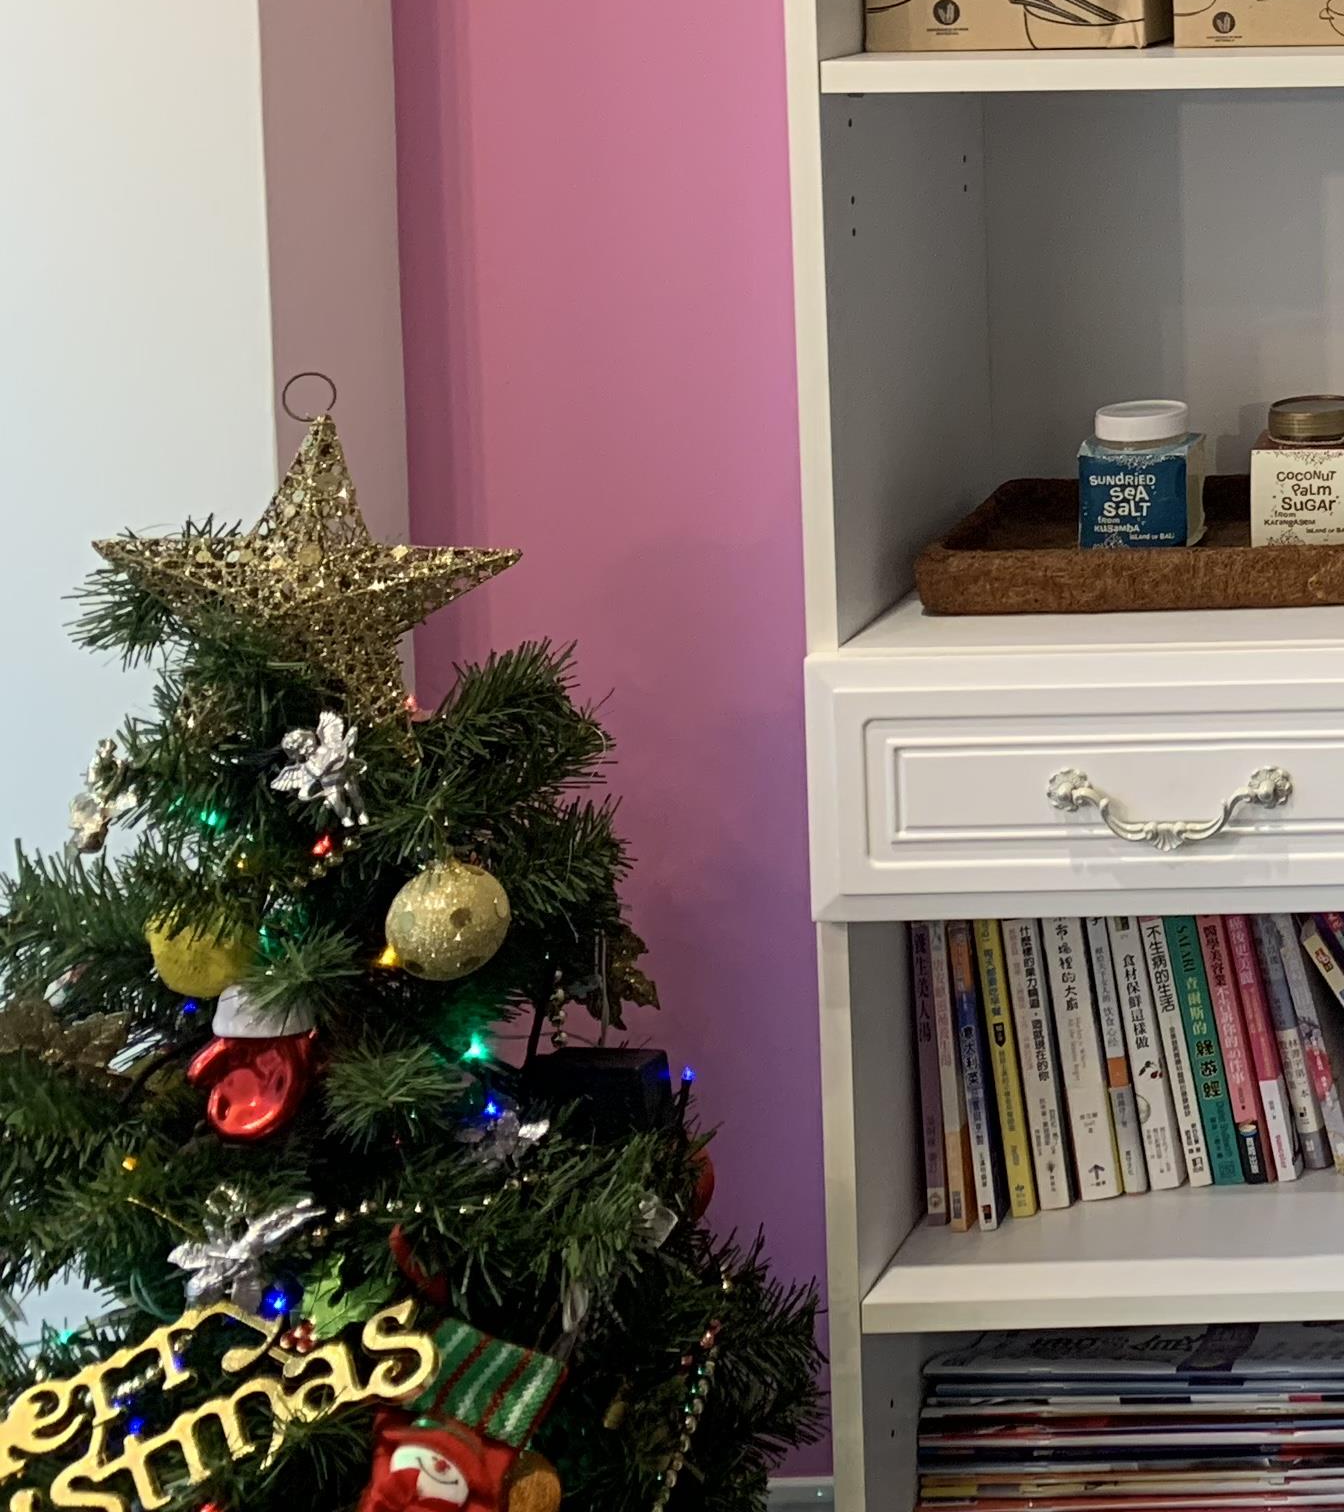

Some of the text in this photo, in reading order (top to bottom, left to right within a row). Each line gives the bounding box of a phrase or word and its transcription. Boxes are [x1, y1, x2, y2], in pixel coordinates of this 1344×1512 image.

[1145, 924, 1176, 1014] 不生病的生活
[0, 1281, 284, 1483] erry
